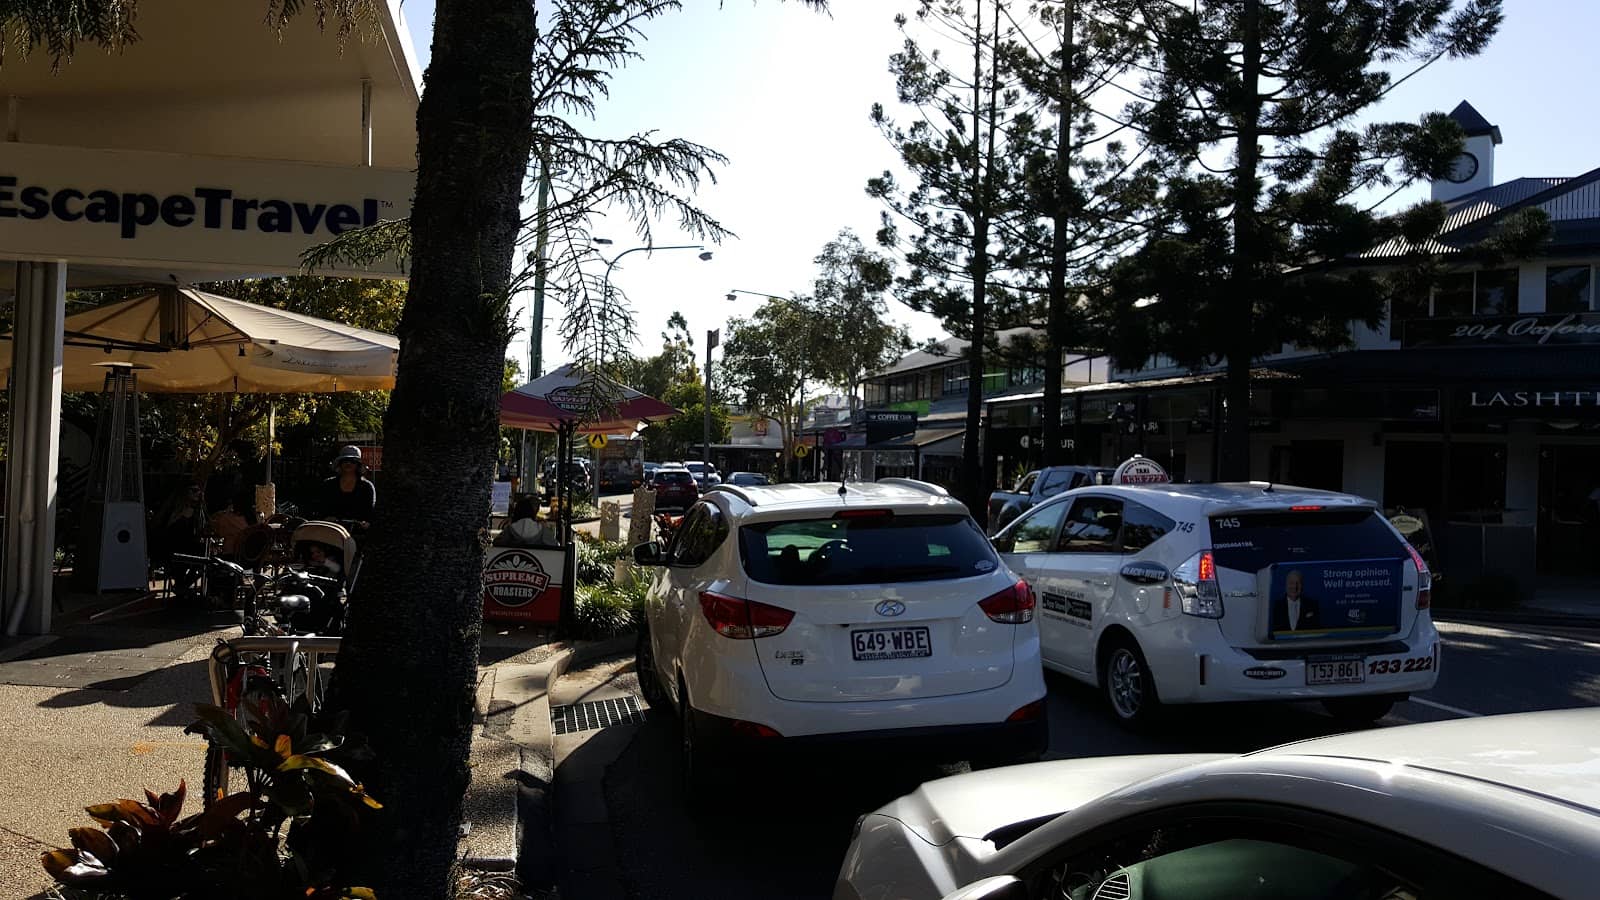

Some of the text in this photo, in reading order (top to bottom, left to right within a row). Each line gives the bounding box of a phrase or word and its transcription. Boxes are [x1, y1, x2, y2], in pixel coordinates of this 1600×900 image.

[1449, 323, 1502, 340] 204
[1471, 391, 1600, 407] LASHT
[877, 413, 899, 421] COFFEE
[1176, 520, 1195, 533] 745
[1215, 517, 1240, 529] 745
[486, 571, 544, 587] SUPREME
[1323, 567, 1391, 579] Strong opinion.
[1323, 579, 1343, 589] Well
[1345, 578, 1392, 590] expressed.
[493, 586, 533, 598] ROASTERS
[1368, 656, 1432, 675] 133 222
